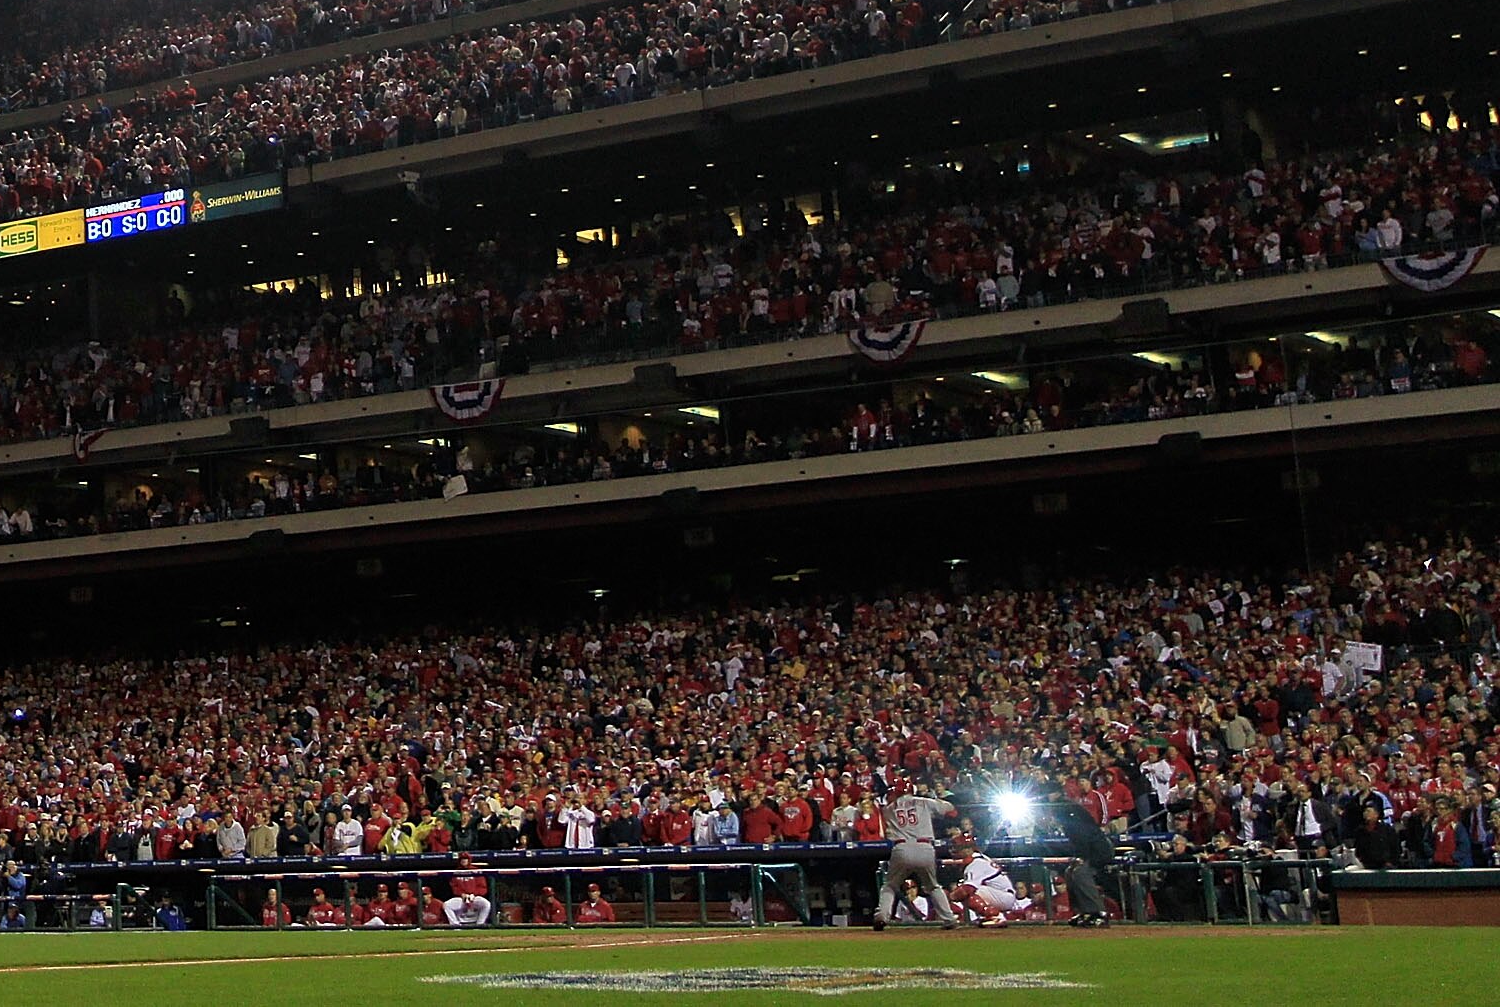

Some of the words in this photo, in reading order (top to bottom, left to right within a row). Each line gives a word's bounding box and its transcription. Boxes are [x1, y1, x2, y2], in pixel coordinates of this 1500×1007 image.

[85, 199, 141, 218] HERNANDEZ
[159, 188, 184, 204] .000
[0, 230, 35, 248] HESS
[896, 808, 918, 827] 55
